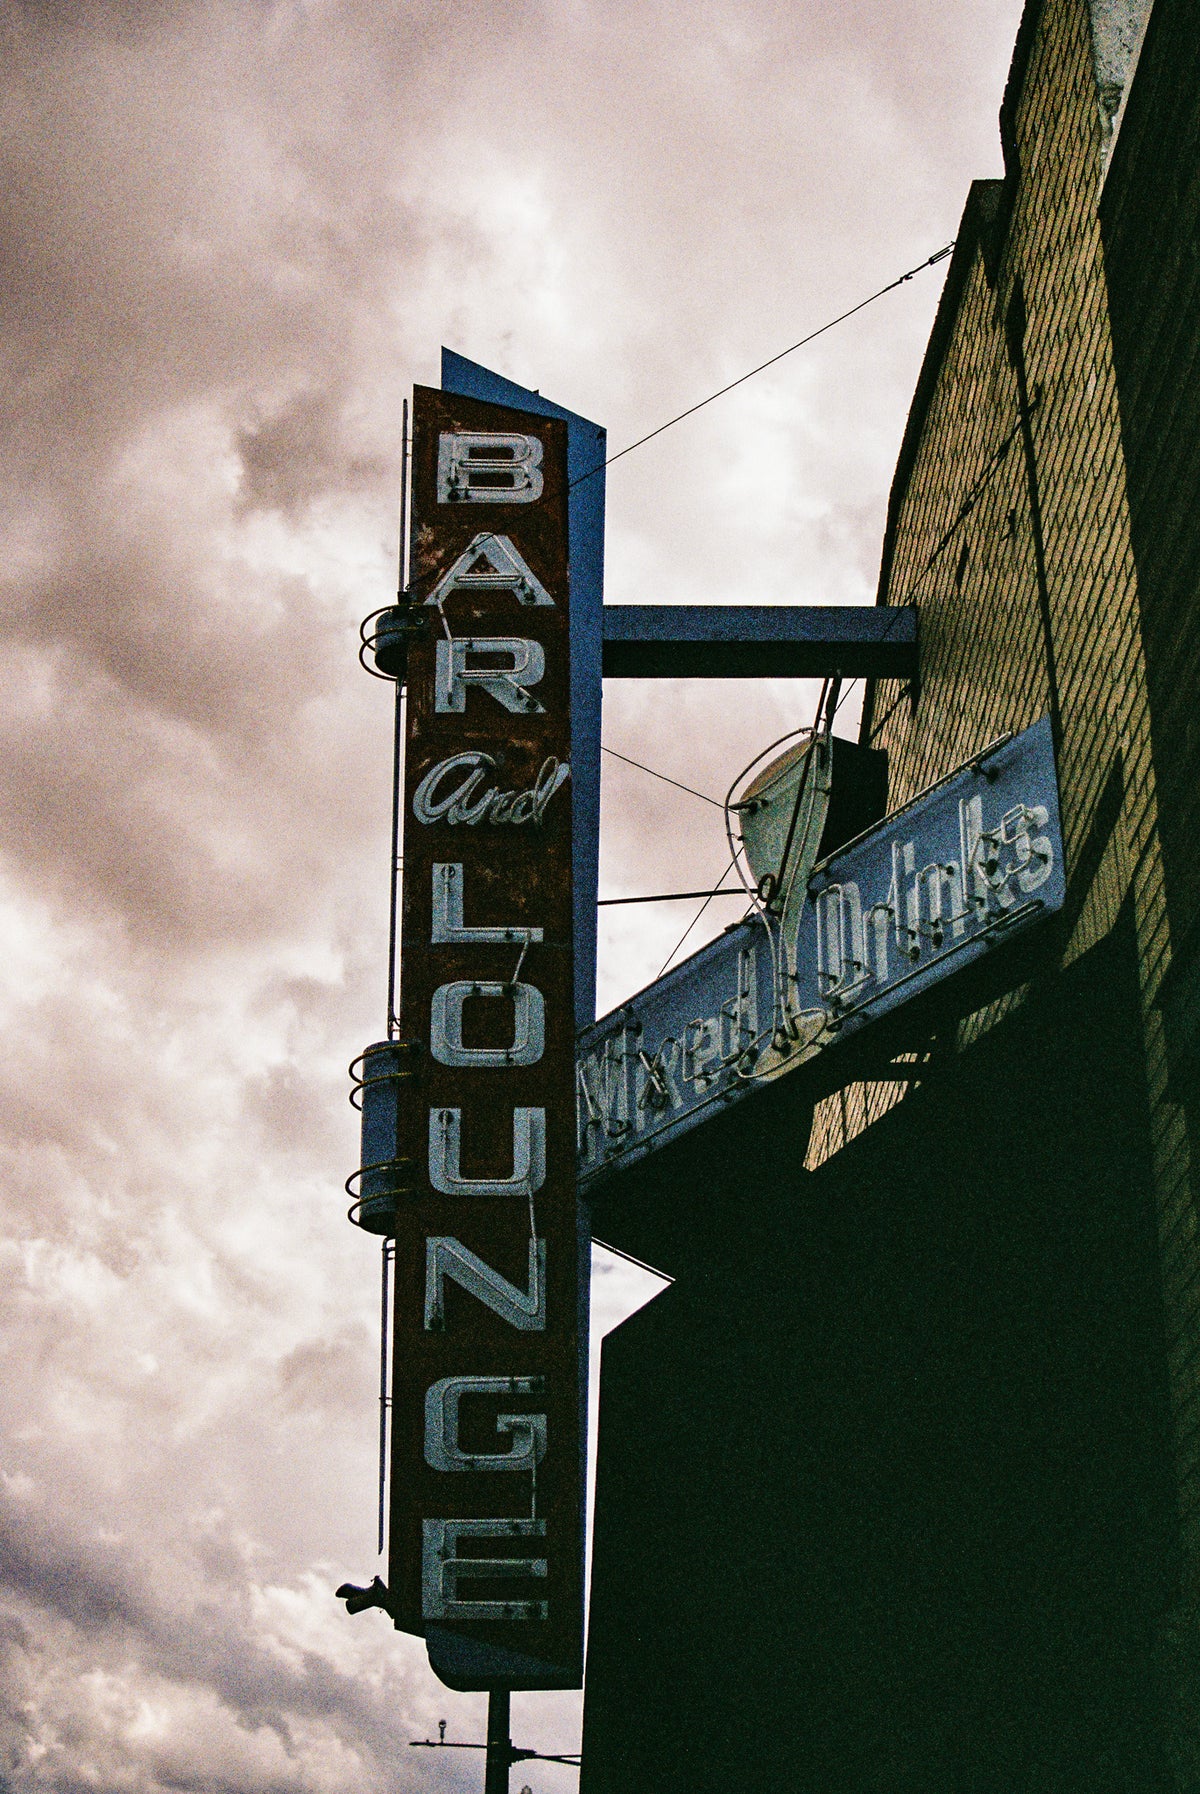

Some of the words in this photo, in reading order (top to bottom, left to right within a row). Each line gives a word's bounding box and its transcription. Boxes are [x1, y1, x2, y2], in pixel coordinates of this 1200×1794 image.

[424, 431, 556, 714] BAR
[411, 750, 571, 827] And
[575, 948, 759, 1163] Mixed
[817, 794, 1054, 1004] Drinks
[420, 861, 551, 1621] LOUNGE
